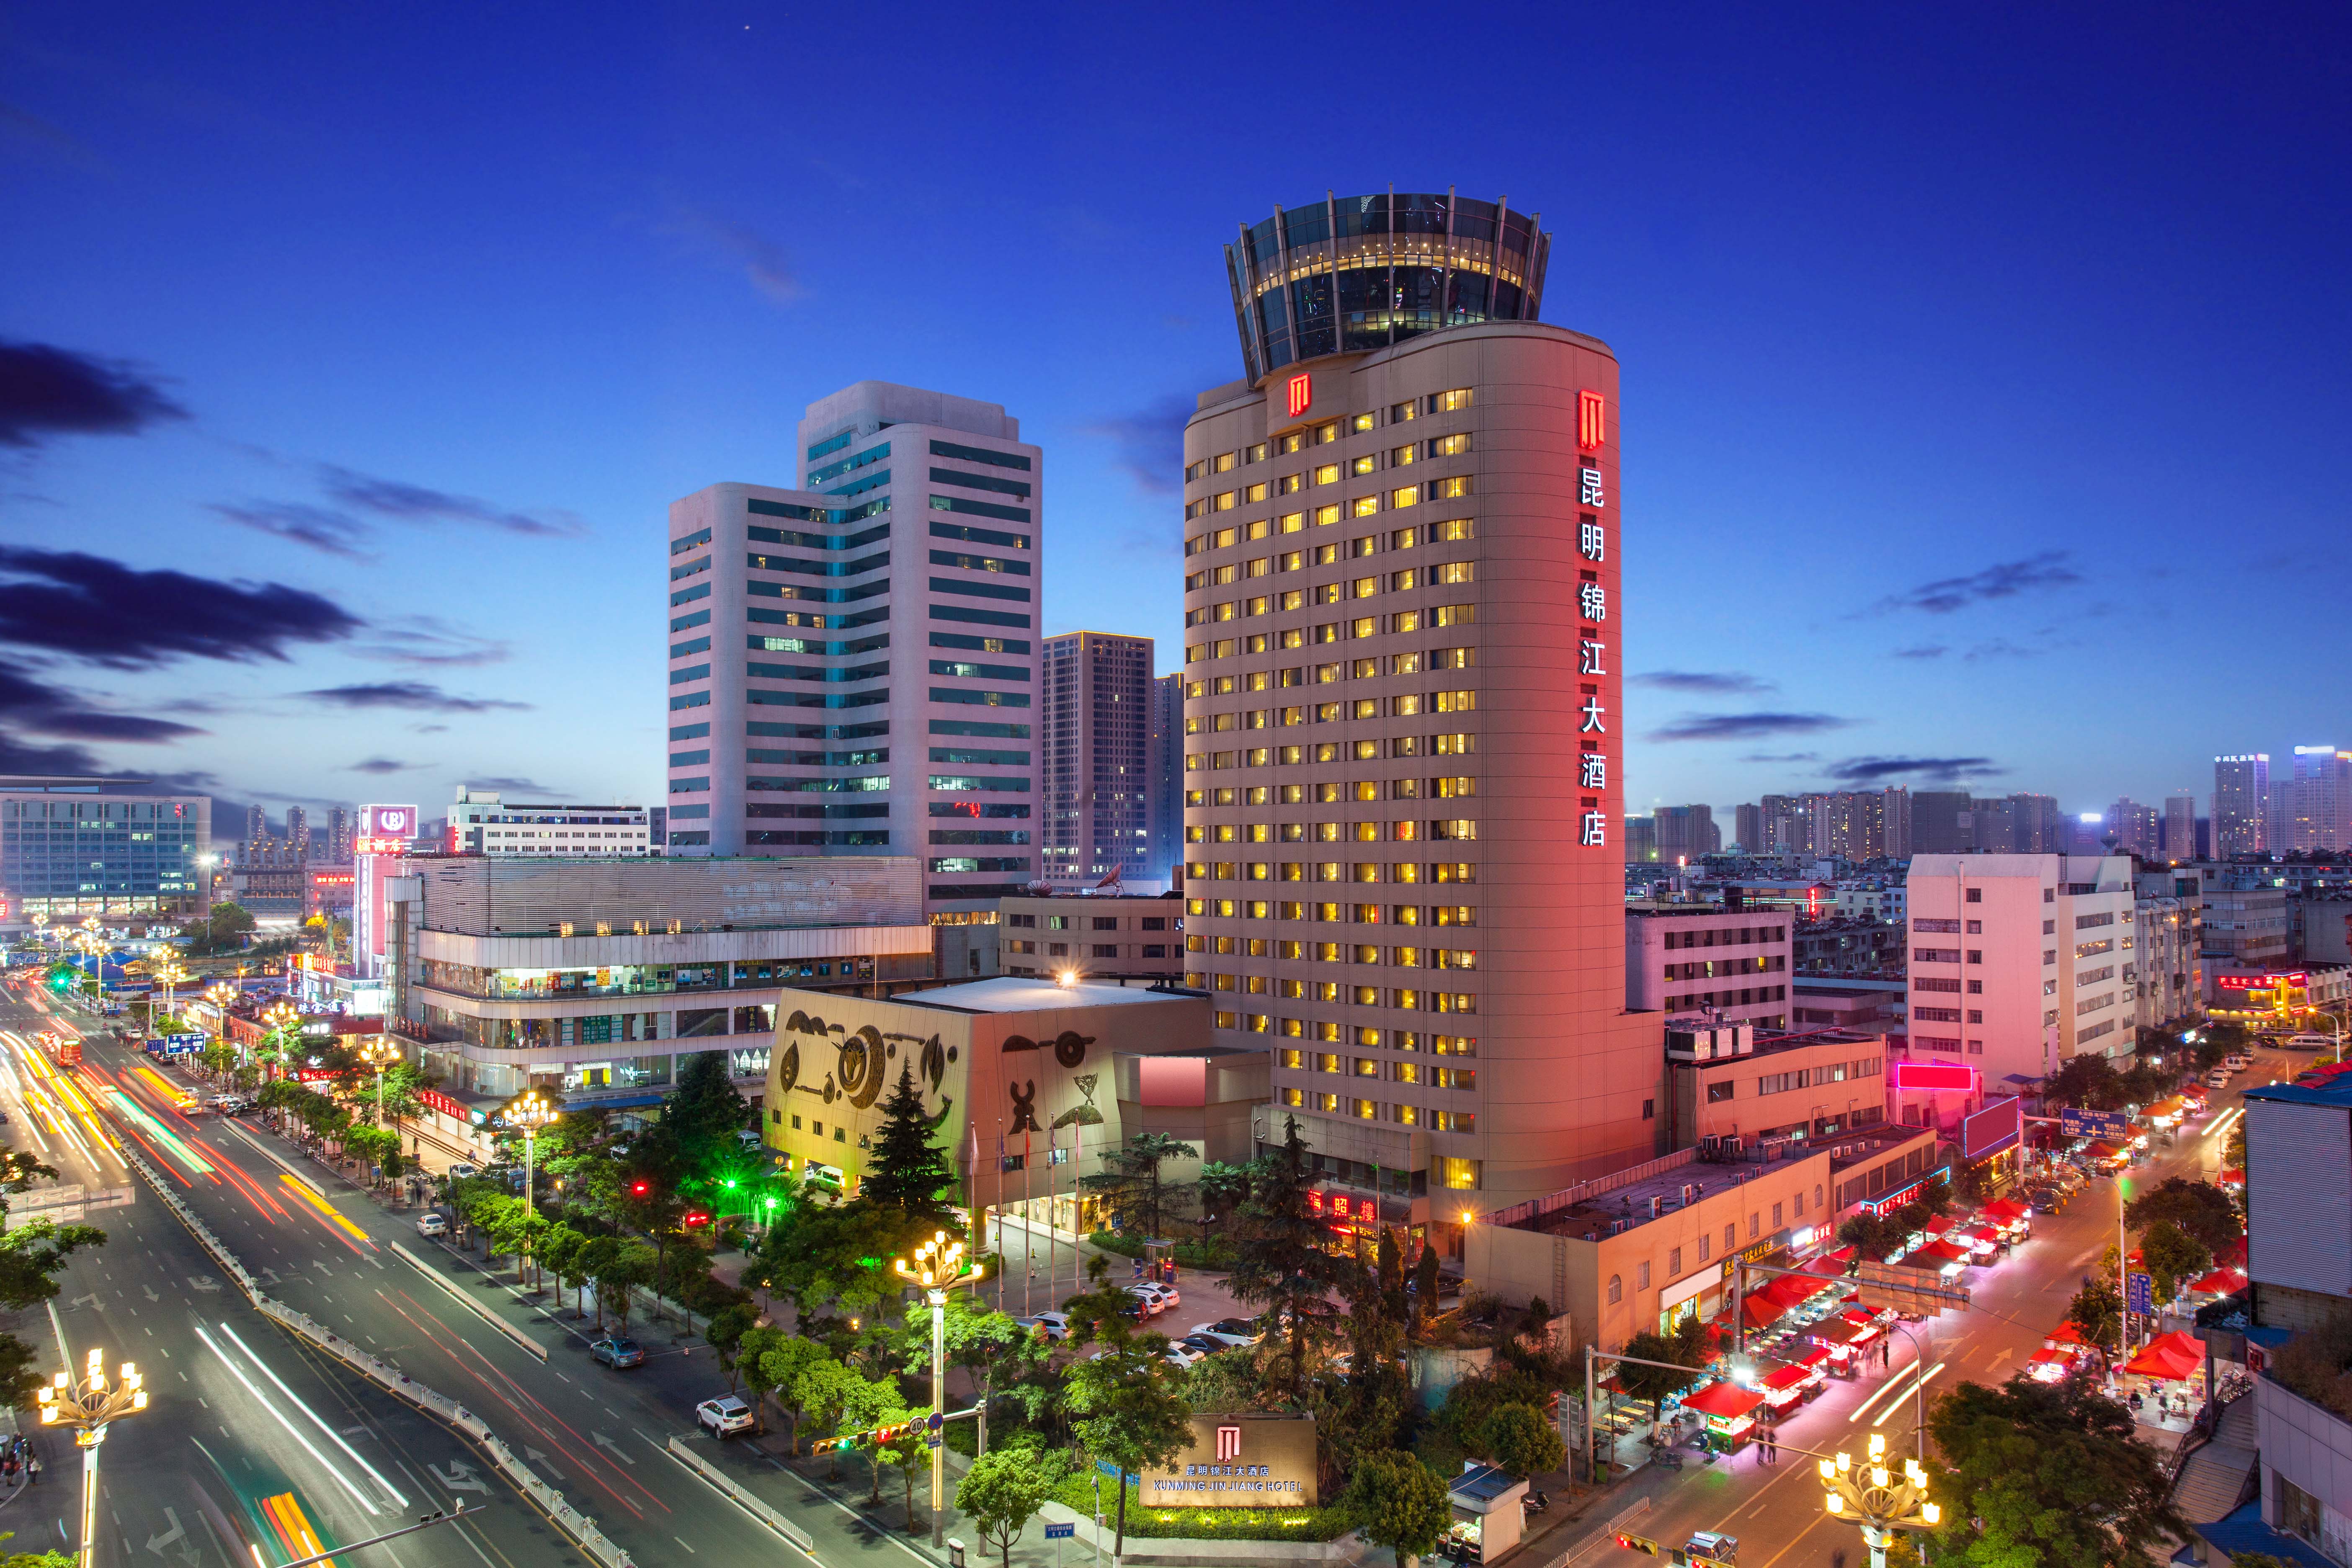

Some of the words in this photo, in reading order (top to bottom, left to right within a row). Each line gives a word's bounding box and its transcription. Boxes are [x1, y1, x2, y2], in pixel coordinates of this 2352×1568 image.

[1582, 468, 1606, 846] 昆明锦江大酒店
[912, 1422, 921, 1431] 40
[1186, 1466, 1269, 1477] 昆明锦江大酒店
[1154, 1481, 1205, 1491] KUNMING
[1209, 1481, 1226, 1491] JIN
[1229, 1481, 1263, 1491] JIANG
[1267, 1481, 1302, 1492] HOTEL
